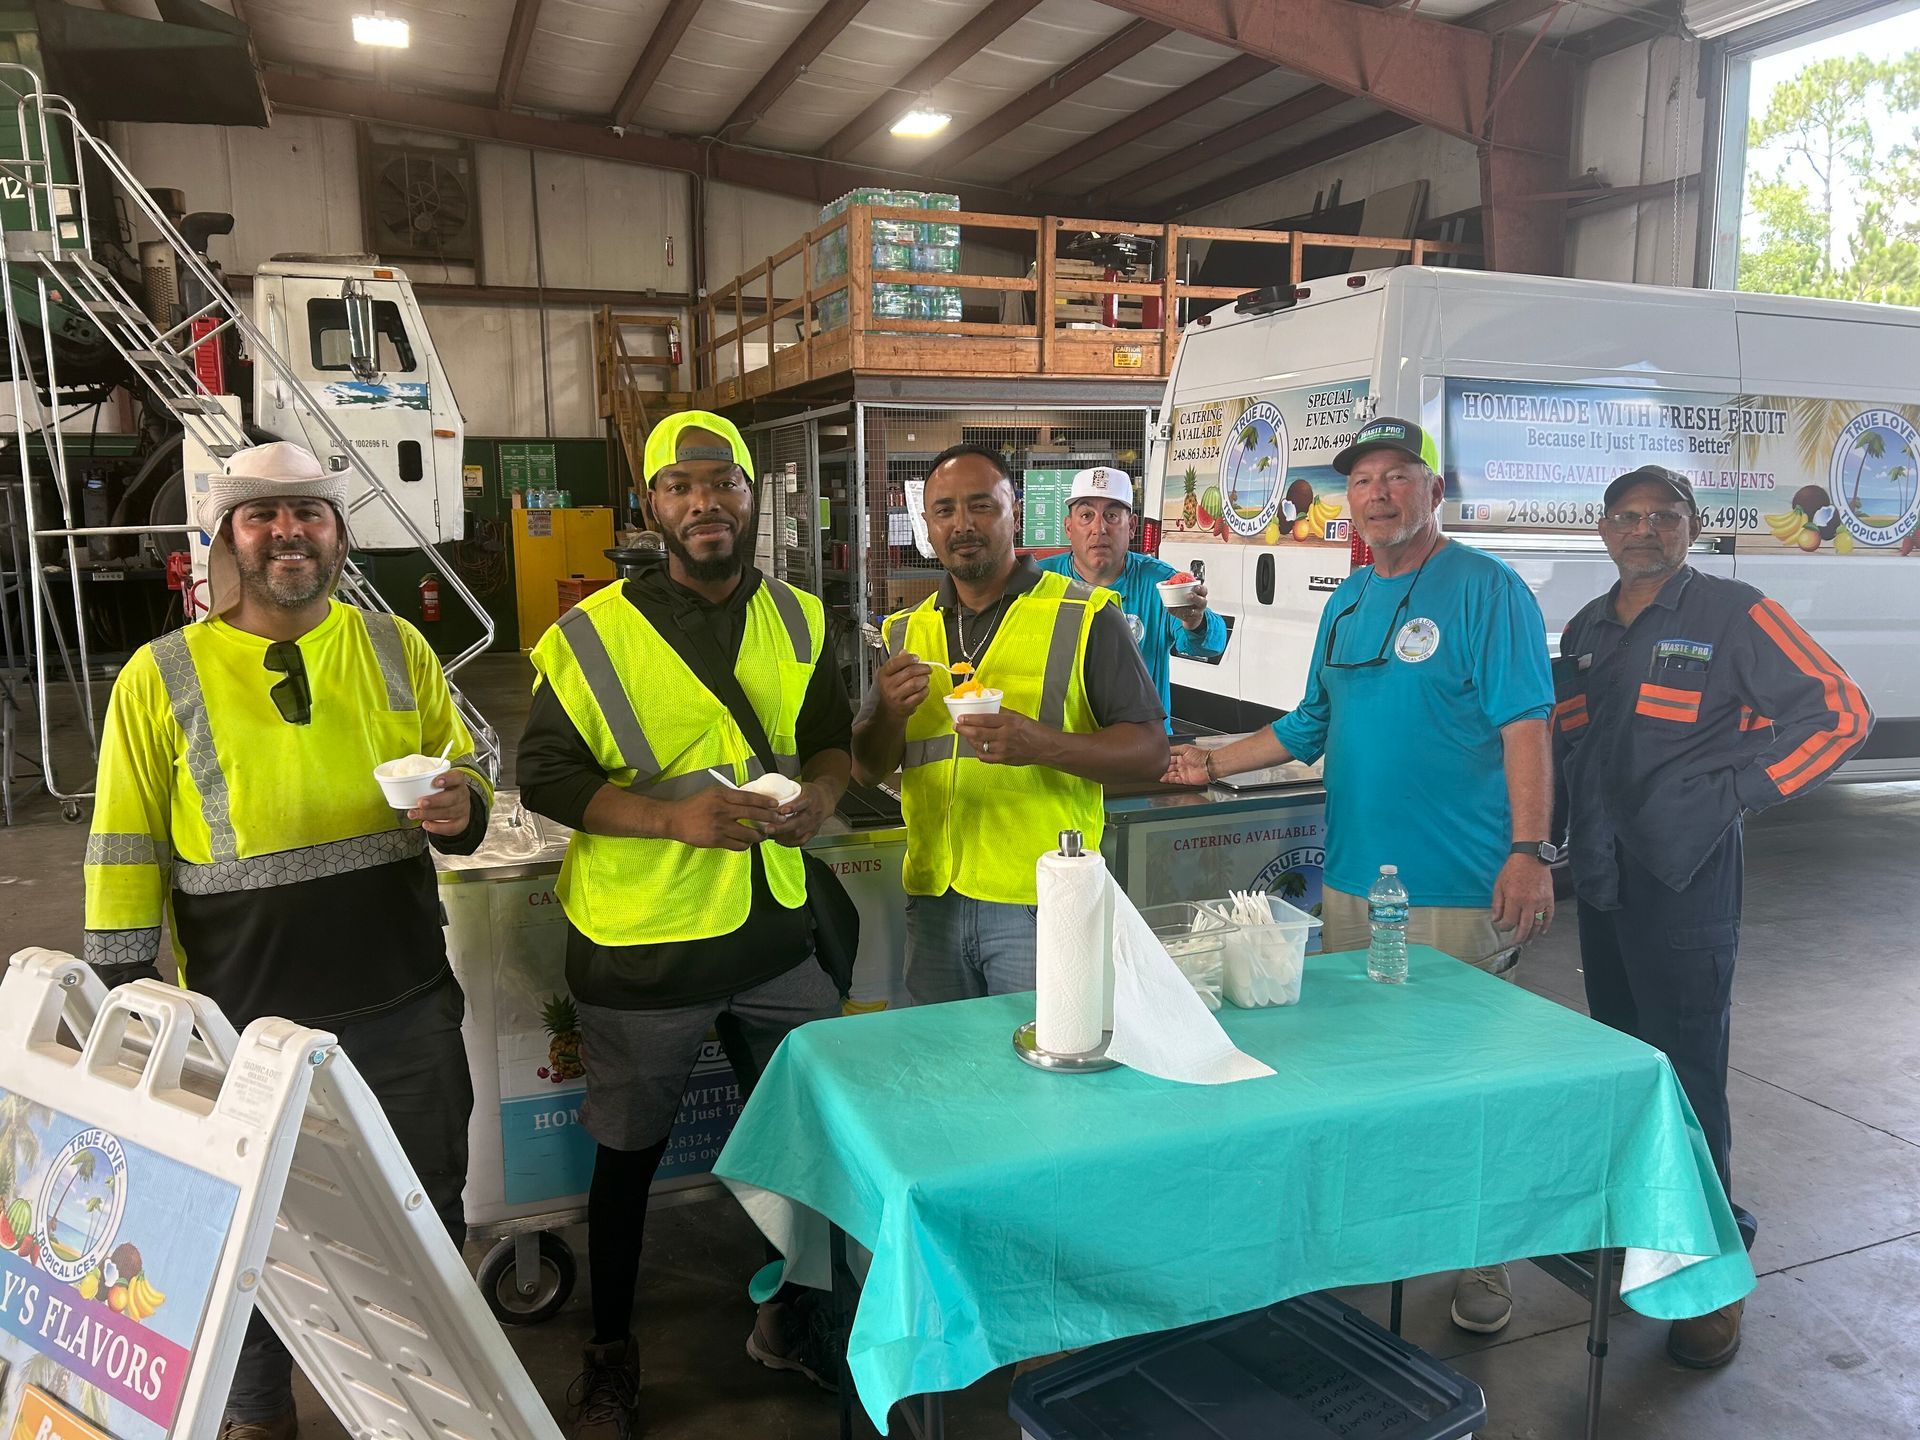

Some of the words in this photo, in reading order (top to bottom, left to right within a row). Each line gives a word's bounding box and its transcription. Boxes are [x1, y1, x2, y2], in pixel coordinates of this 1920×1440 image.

[1307, 389, 1353, 409] SPECIAL
[1180, 407, 1223, 425] CATERING
[1233, 406, 1258, 435] TRUE
[1259, 405, 1282, 432] LOVE
[1306, 409, 1350, 427] EVENTS
[1463, 393, 1590, 424] HOMEMADE
[1596, 401, 1652, 429] WITH
[1659, 405, 1722, 431] FRESH
[1728, 409, 1787, 434] FRUIT
[1176, 424, 1223, 441] AVAILABLE
[1385, 426, 1401, 434] PRO
[1845, 412, 1879, 439] TRUE
[1883, 412, 1917, 444] LOVE
[1173, 446, 1220, 461] 248.863.8324
[1528, 428, 1586, 448] Because
[1590, 431, 1602, 449] It
[1605, 432, 1635, 454] Just
[1639, 434, 1684, 453] Tastes
[1688, 436, 1731, 455] Better
[1486, 461, 1562, 481] CATERING
[1567, 465, 1632, 483] AVAILA
[1720, 471, 1775, 489] EVENTS
[1223, 501, 1258, 533] TROPICAL
[1259, 501, 1276, 527] ICES
[1697, 506, 1758, 529] 6.4998
[1840, 509, 1893, 542] TROPICAL
[1895, 511, 1918, 536] ICES
[1660, 642, 1689, 653] WASTE
[1692, 645, 1709, 656] PRO
[1173, 833, 1241, 851] CATERING
[1245, 825, 1317, 843] AVAILABLE
[1260, 851, 1301, 883] TRUE
[681, 1084, 741, 1107] WITH
[690, 1105, 722, 1125] Just
[69, 1131, 101, 1154] TRUE
[100, 1134, 125, 1175] LOVE
[679, 1152, 696, 1164] US
[37, 1227, 70, 1278] TROPICAL
[73, 1254, 96, 1277] ICES
[38, 1295, 168, 1401] FLAVORS
